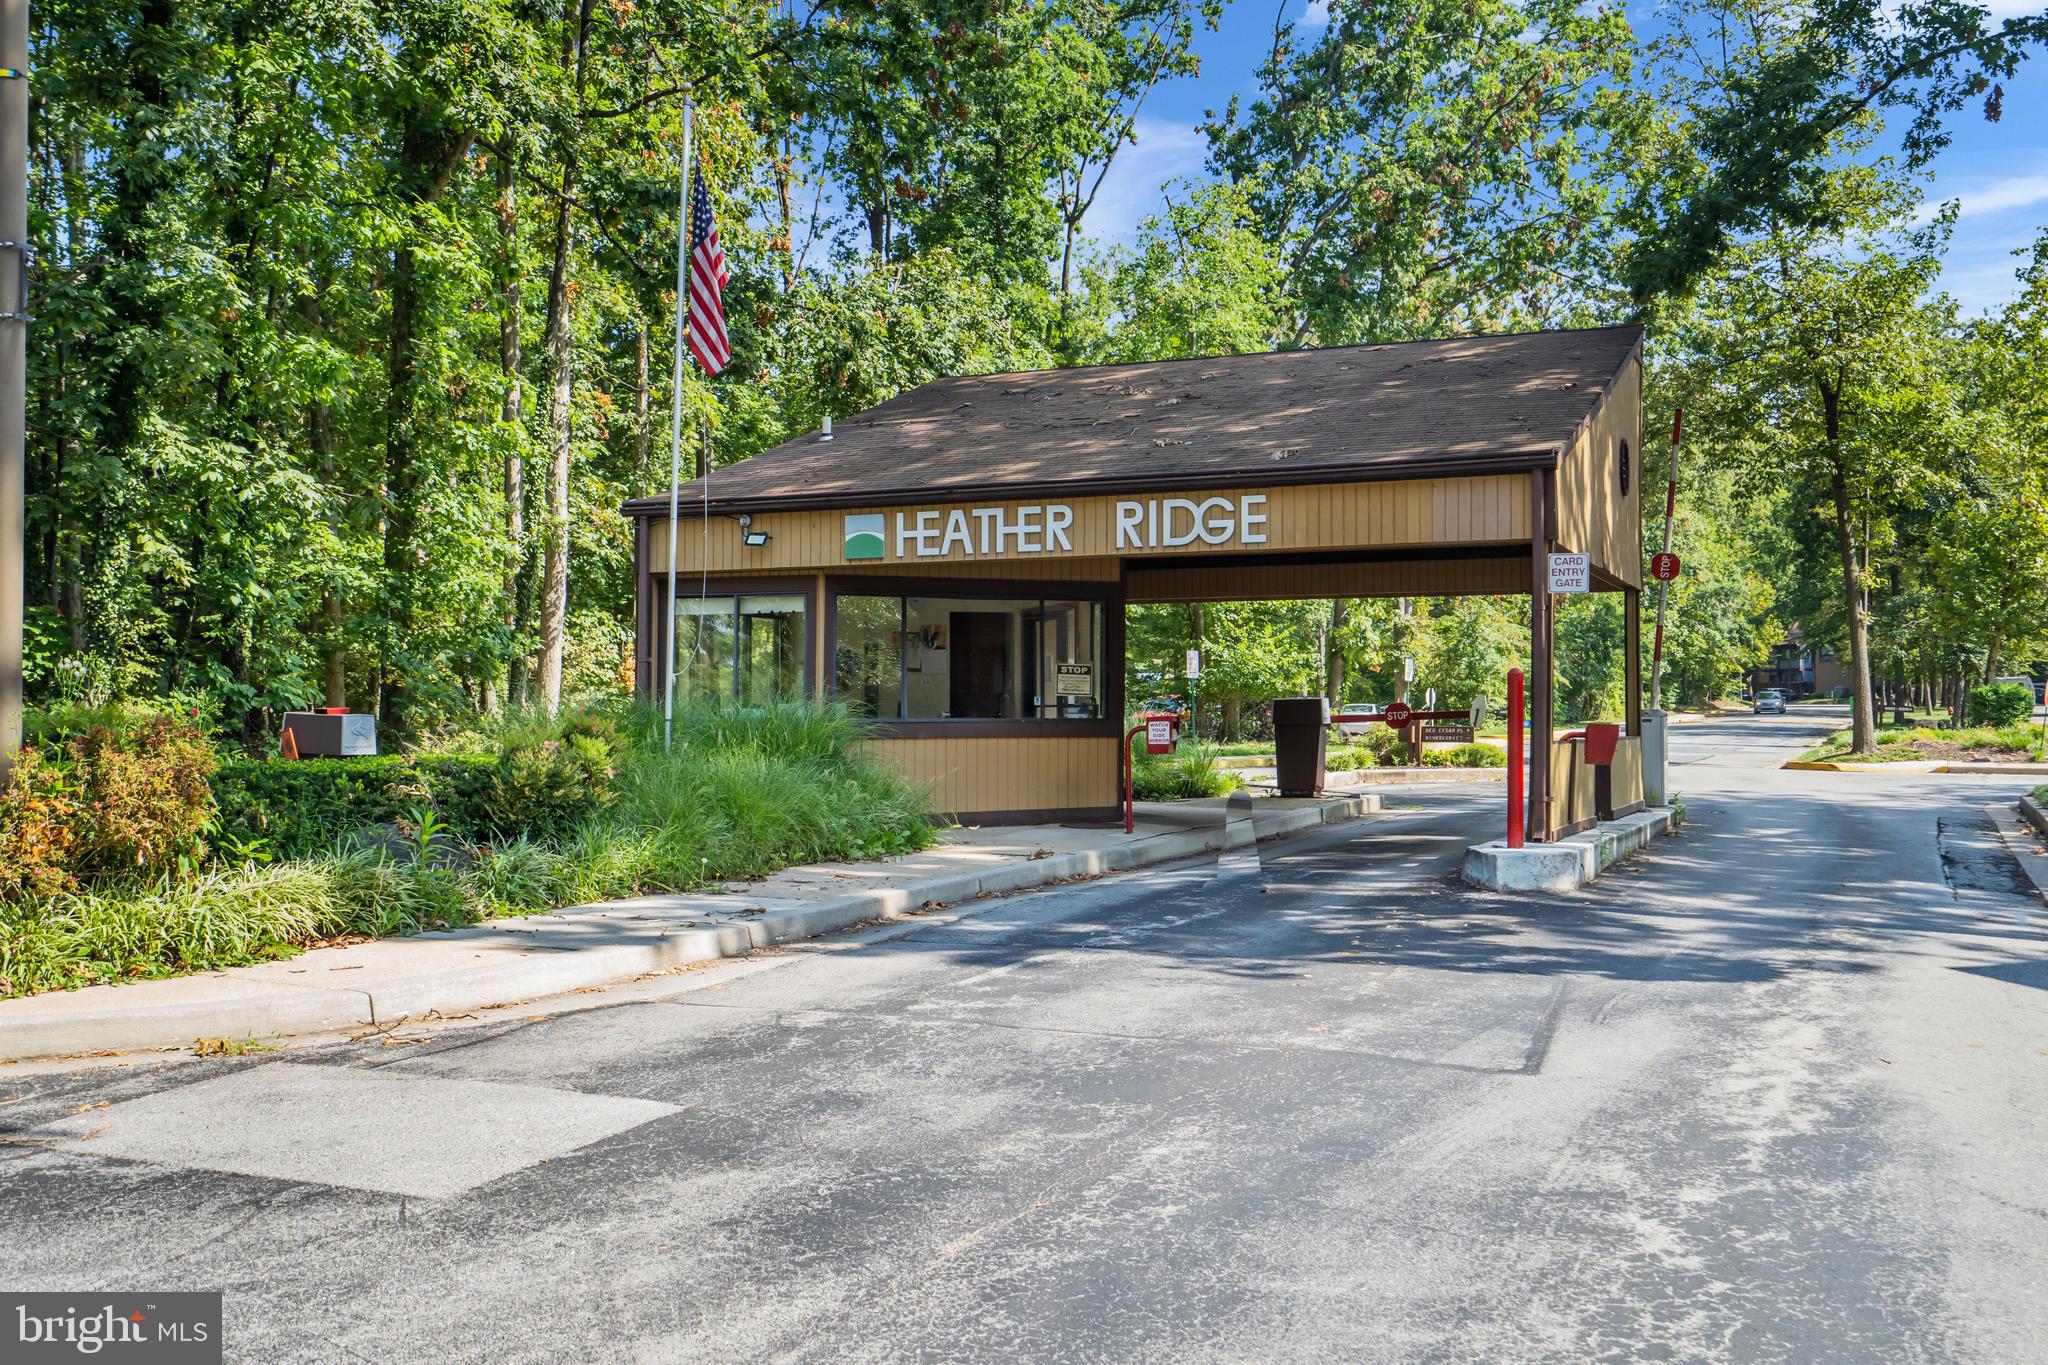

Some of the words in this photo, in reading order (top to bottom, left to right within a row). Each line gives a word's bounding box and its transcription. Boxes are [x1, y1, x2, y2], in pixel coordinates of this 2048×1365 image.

[895, 504, 1074, 558] HEATHER
[1116, 494, 1268, 549] RIDGE
[1554, 557, 1583, 566] CARD
[1660, 555, 1672, 579] STOP
[1551, 568, 1586, 577] ENTRY
[1555, 578, 1583, 587] GATE
[1060, 665, 1088, 674] STOP
[1387, 711, 1409, 720] STOP
